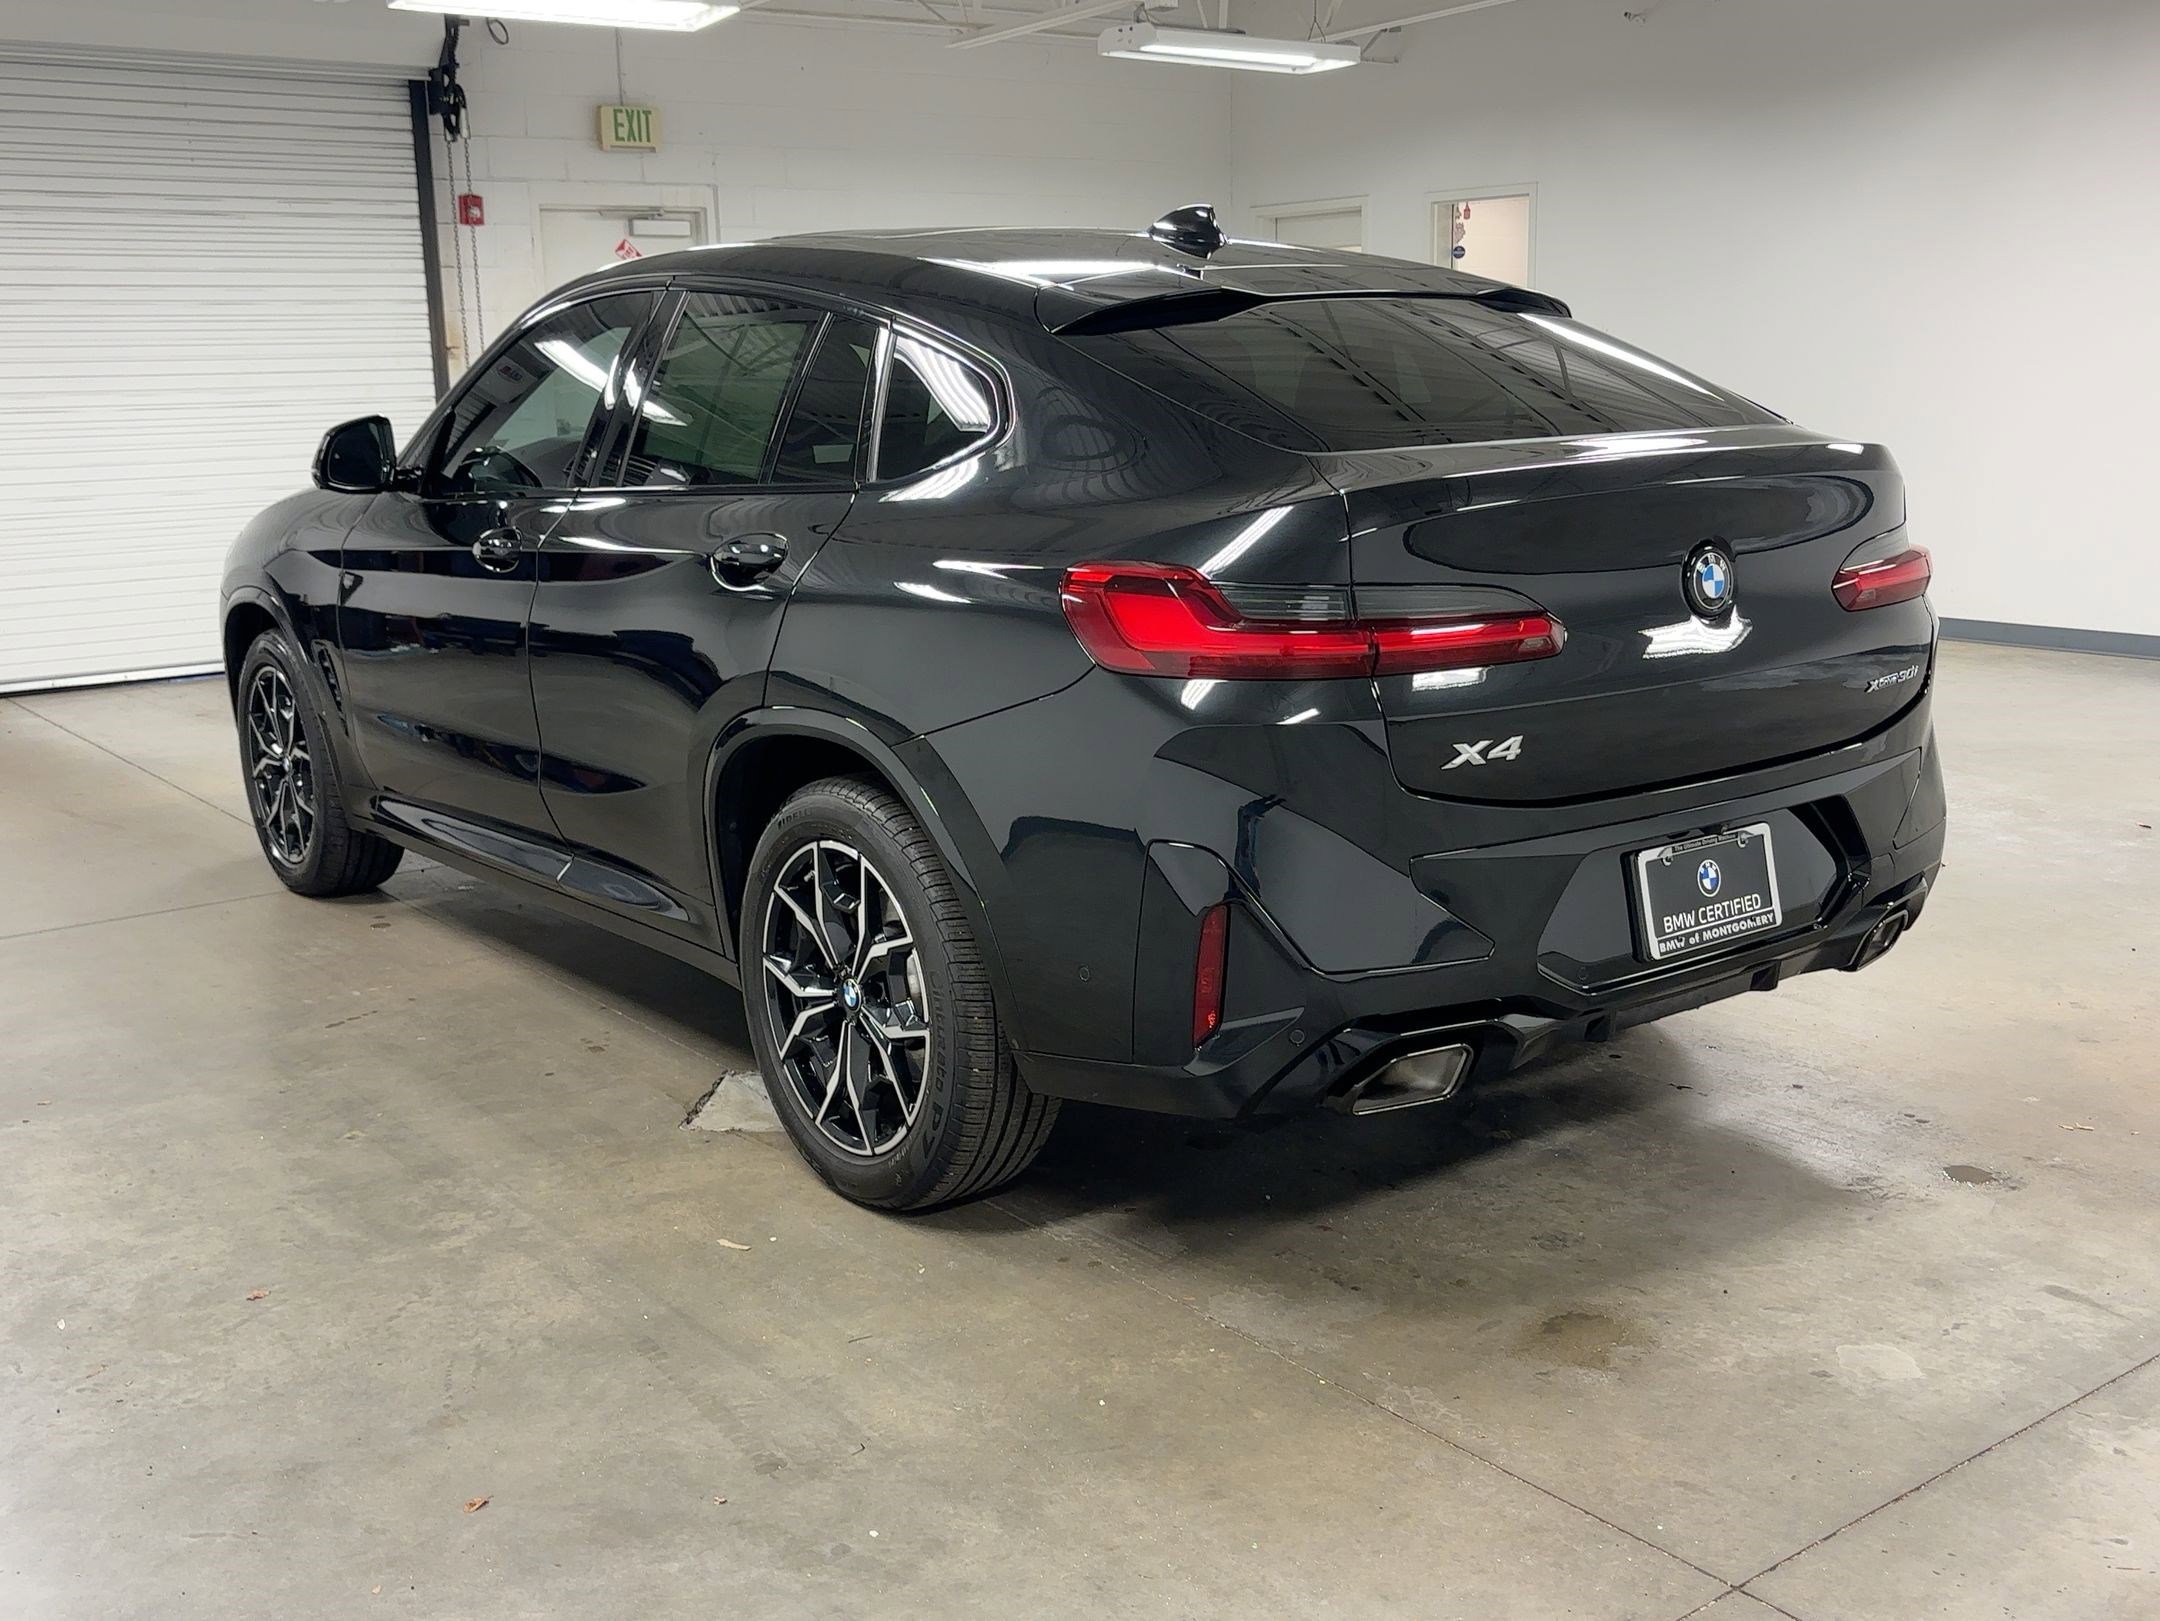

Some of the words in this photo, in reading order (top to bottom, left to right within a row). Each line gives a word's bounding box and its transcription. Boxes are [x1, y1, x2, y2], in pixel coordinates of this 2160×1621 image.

[613, 109, 652, 143] EXIT
[1440, 735, 1524, 770] X4
[1659, 936, 1686, 953] BMW
[1689, 932, 1700, 945] of
[1702, 912, 1774, 942] MONTGOMERY
[1663, 909, 1695, 934] BMW
[1698, 893, 1762, 924] CERTIFIED
